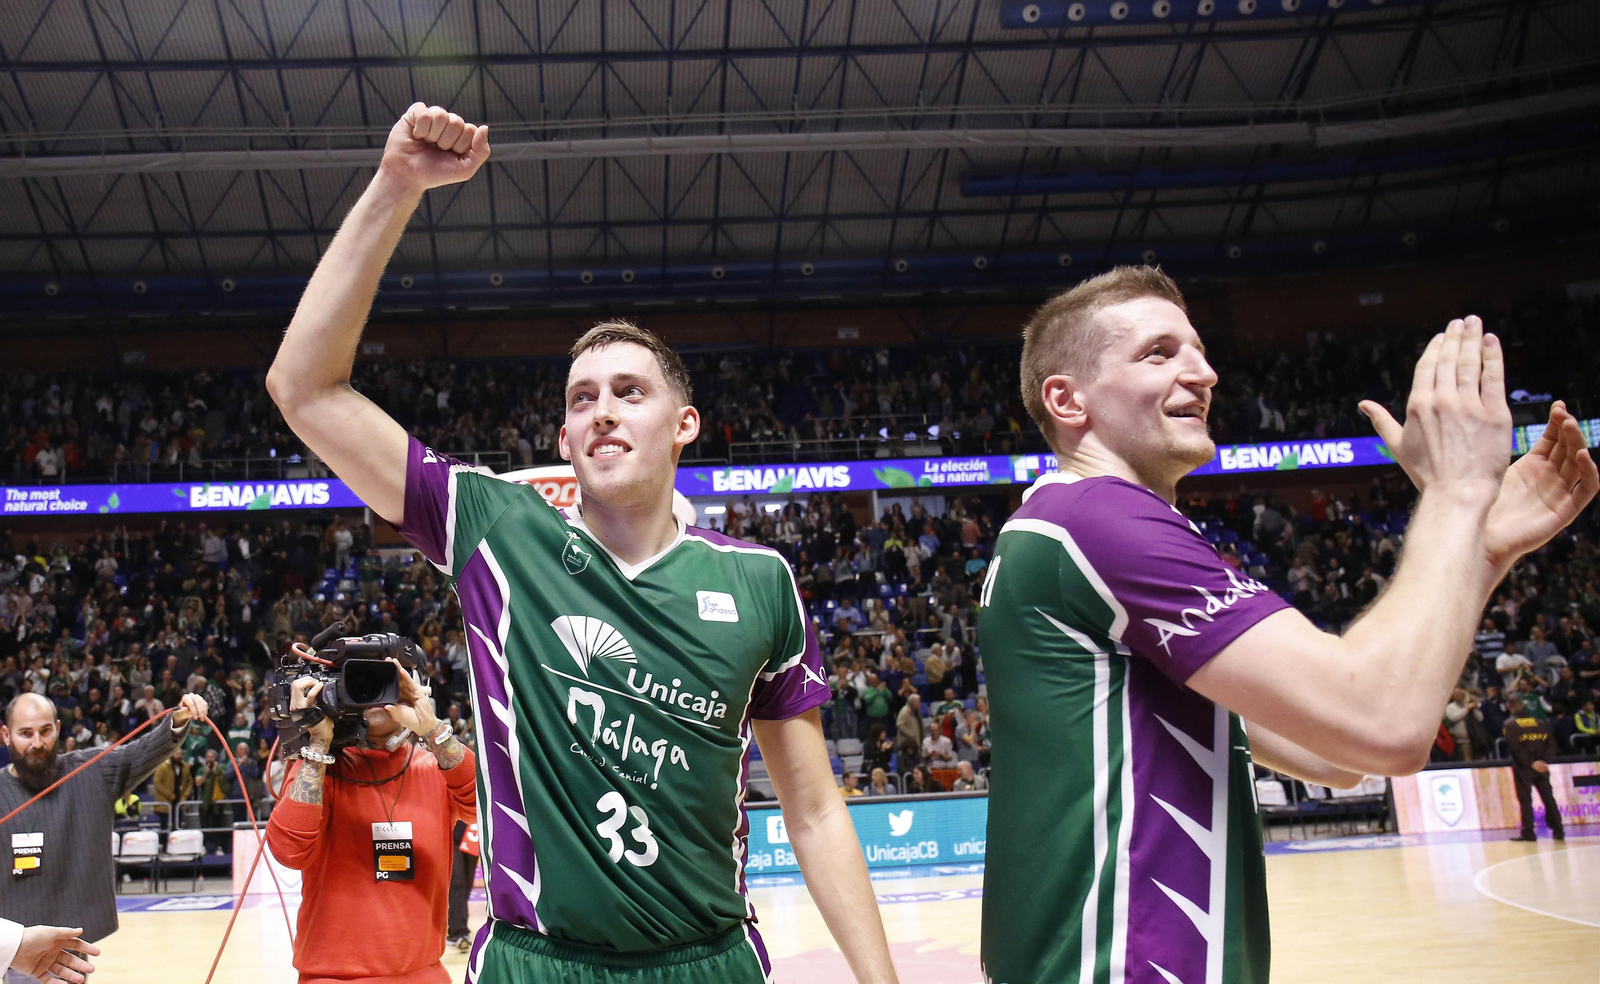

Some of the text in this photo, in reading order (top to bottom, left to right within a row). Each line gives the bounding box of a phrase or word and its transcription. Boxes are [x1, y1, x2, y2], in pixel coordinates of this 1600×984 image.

[924, 458, 987, 473] La elección
[6, 488, 61, 500] The most
[4, 498, 88, 512] natural choice
[627, 667, 728, 721] Unicaja
[595, 791, 660, 867] 33
[13, 847, 42, 855] PRENSA
[375, 842, 412, 850] PRENSA
[866, 840, 939, 863] UnicajaCB
[376, 871, 389, 879] PG
